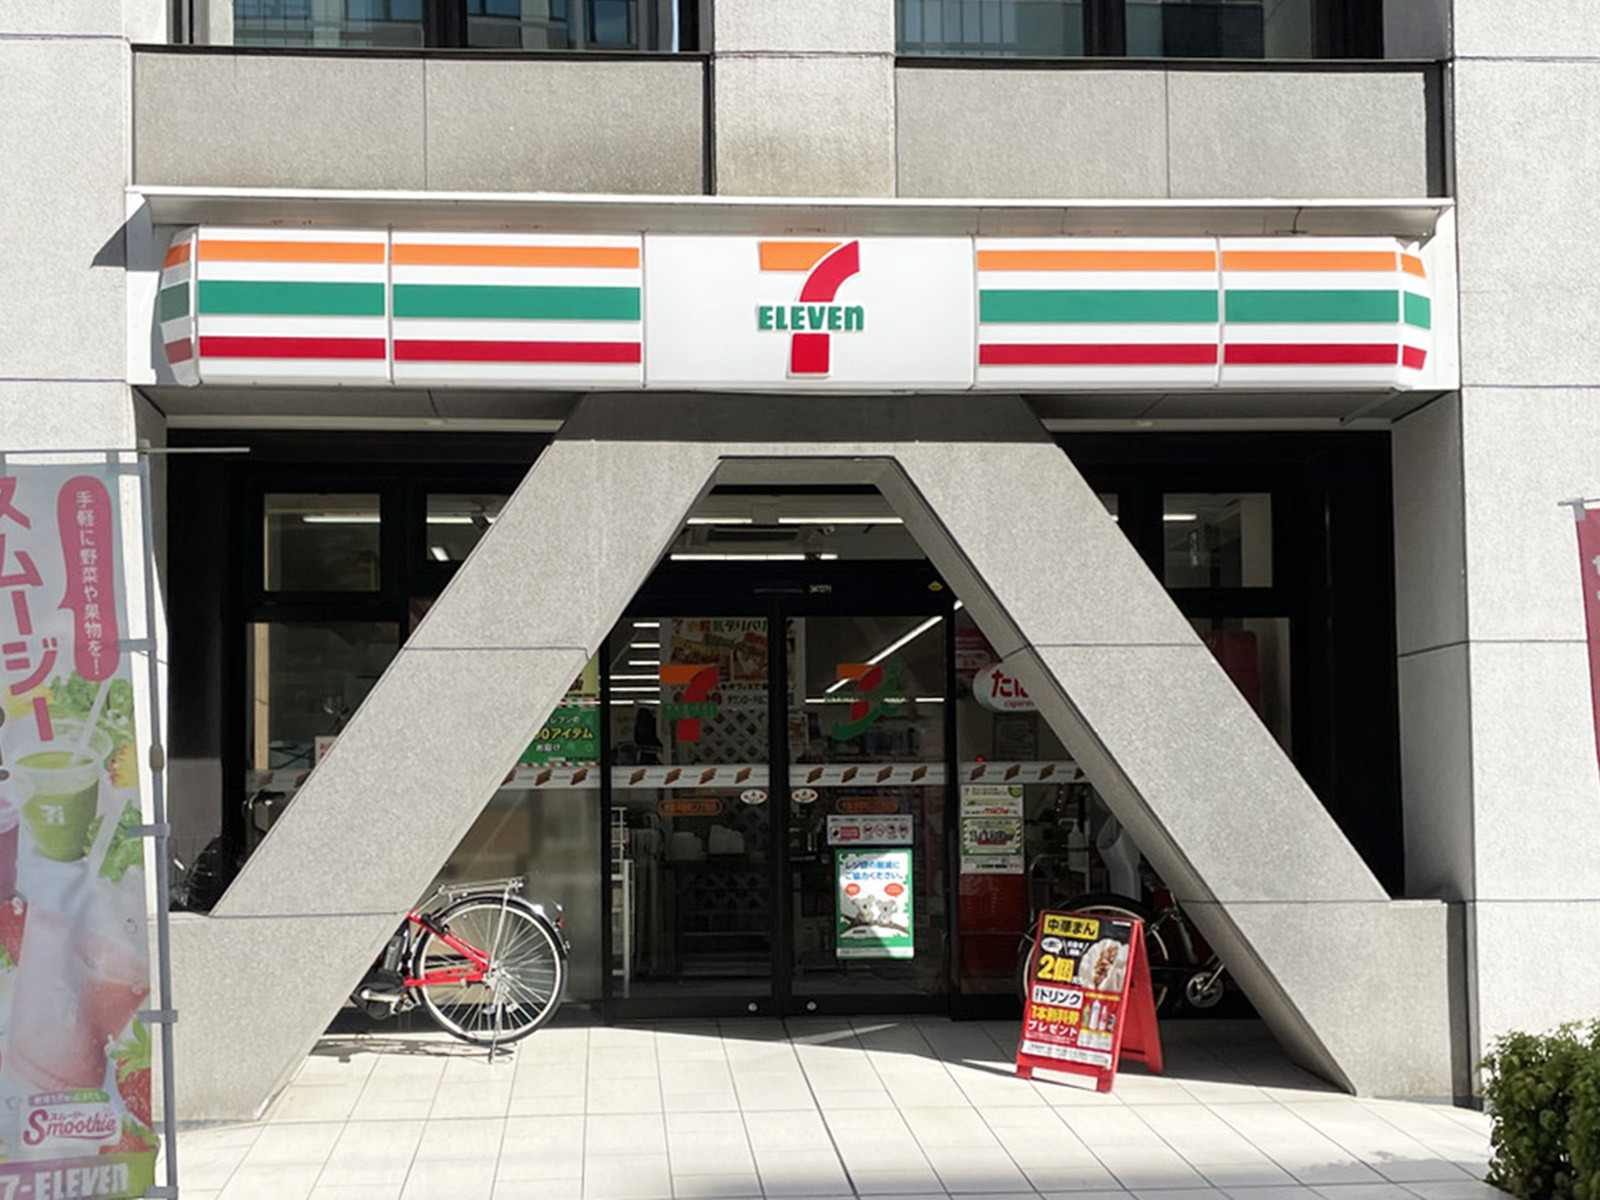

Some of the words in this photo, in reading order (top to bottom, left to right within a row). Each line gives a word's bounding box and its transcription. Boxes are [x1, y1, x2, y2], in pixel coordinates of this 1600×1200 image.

[758, 240, 860, 374] 7
[1047, 918, 1096, 936] 中華まん
[23, 1108, 116, 1146] Smoothie
